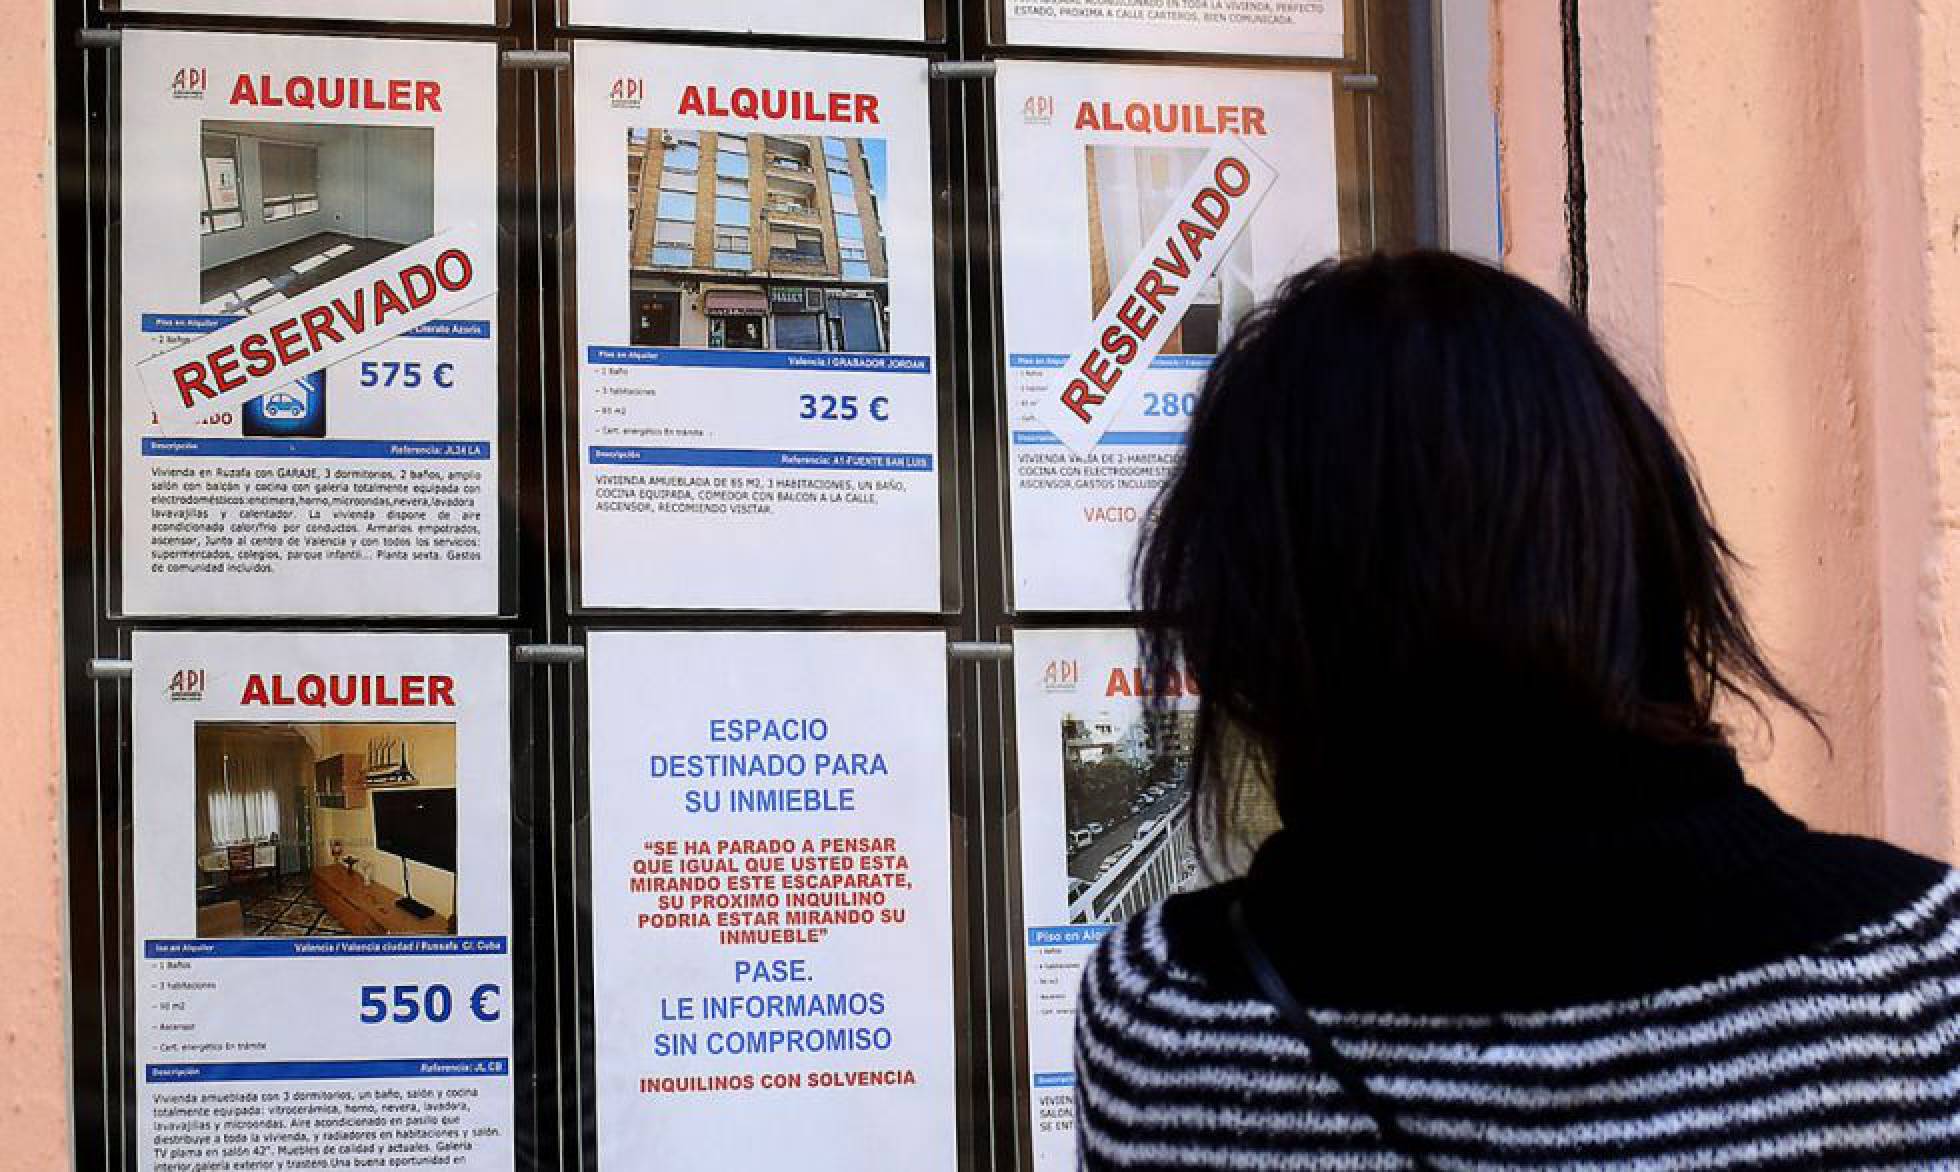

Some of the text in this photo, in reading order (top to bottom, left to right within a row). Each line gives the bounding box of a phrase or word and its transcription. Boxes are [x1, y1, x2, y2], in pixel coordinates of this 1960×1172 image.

[229, 74, 441, 111] ALQUILER
[678, 86, 879, 122] ALQUILER
[1074, 101, 1266, 135] ALQUILER
[1060, 157, 1251, 424] RESERVADO
[172, 248, 474, 409] RESERVADO
[360, 361, 453, 388] 575 €
[800, 394, 888, 421] 325 €
[240, 673, 454, 707] ALQUILER
[710, 718, 827, 741] ESPACIO
[650, 753, 887, 777] DESTINADO PARA
[685, 788, 854, 812] SU INMIEBLE
[684, 840, 710, 854] HA
[717, 839, 795, 854] PARADO
[802, 839, 814, 852] A
[821, 837, 895, 852] PENSAR
[633, 855, 908, 874] QUE IGUAL QUE USTED ESTA
[630, 872, 911, 892] MIRANDO ESTE ESCAPARATE,
[658, 891, 884, 910] SU PROXIMO INQUILINO
[638, 908, 904, 927] PODRIA ESTAR MIRANDO SU
[735, 959, 812, 982] PASE.
[360, 983, 499, 1023] 550 €
[661, 993, 884, 1020] LE INFORMAMOS
[654, 1028, 891, 1056] SIN COMPROMISO
[640, 1070, 915, 1092] INQUILINOS CON SOLVENCIA
